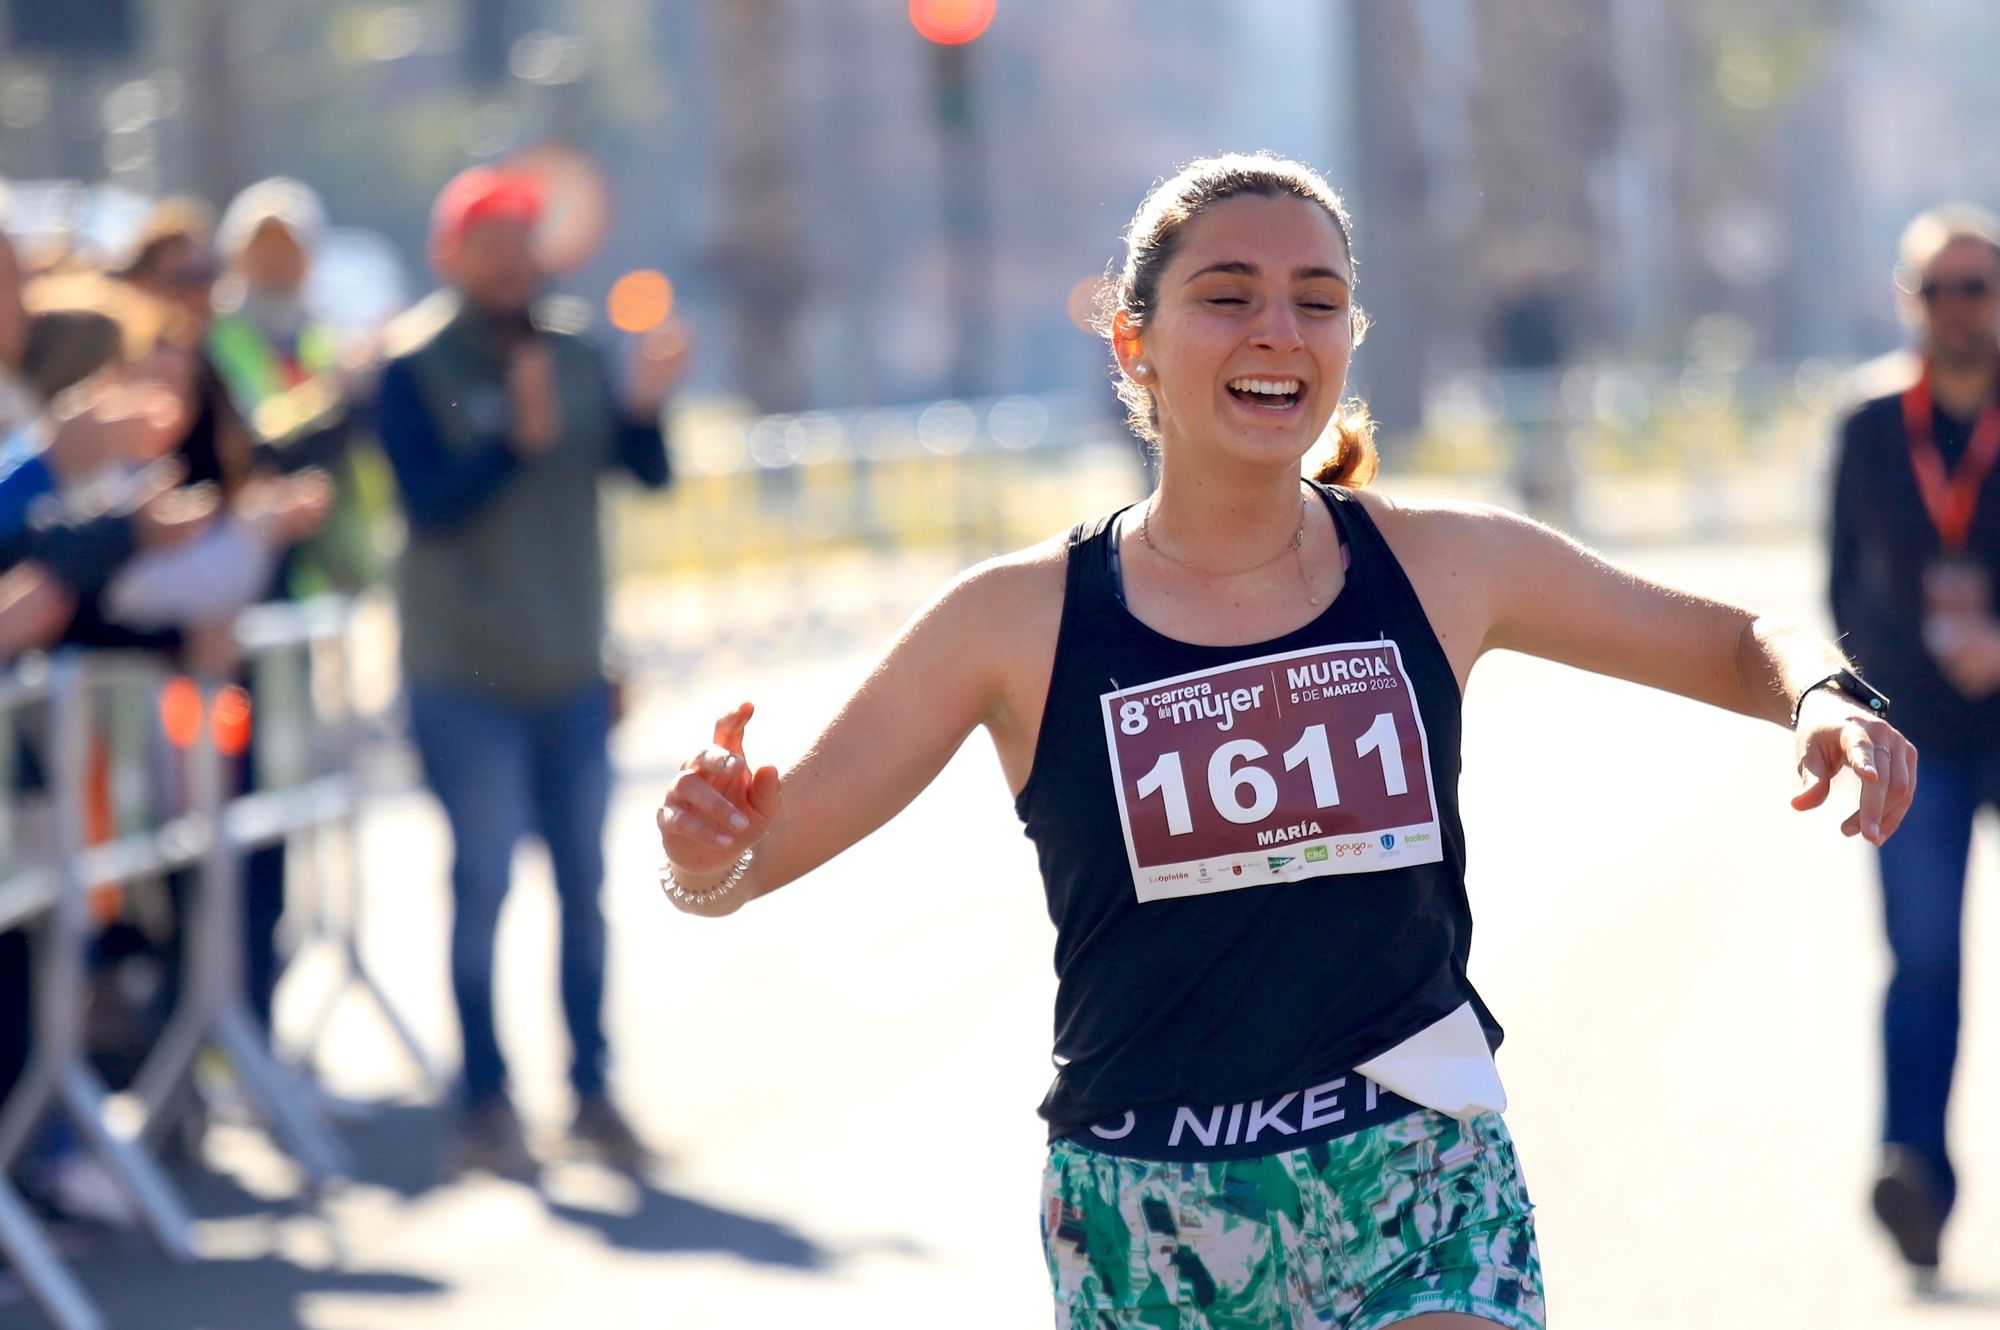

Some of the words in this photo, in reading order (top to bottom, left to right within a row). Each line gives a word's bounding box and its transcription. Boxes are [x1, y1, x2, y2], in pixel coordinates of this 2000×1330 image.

[1287, 656, 1391, 690] MURCIA
[1151, 682, 1212, 706] carrera
[1172, 684, 1264, 731] mujer
[1291, 693, 1300, 703] 5
[1302, 689, 1320, 702] DE
[1322, 682, 1368, 698] MARZO
[1370, 678, 1398, 691] 2023
[1136, 713, 1408, 837] 1611
[1256, 820, 1322, 846] MARÍA
[1167, 1076, 1346, 1147] NIKE
